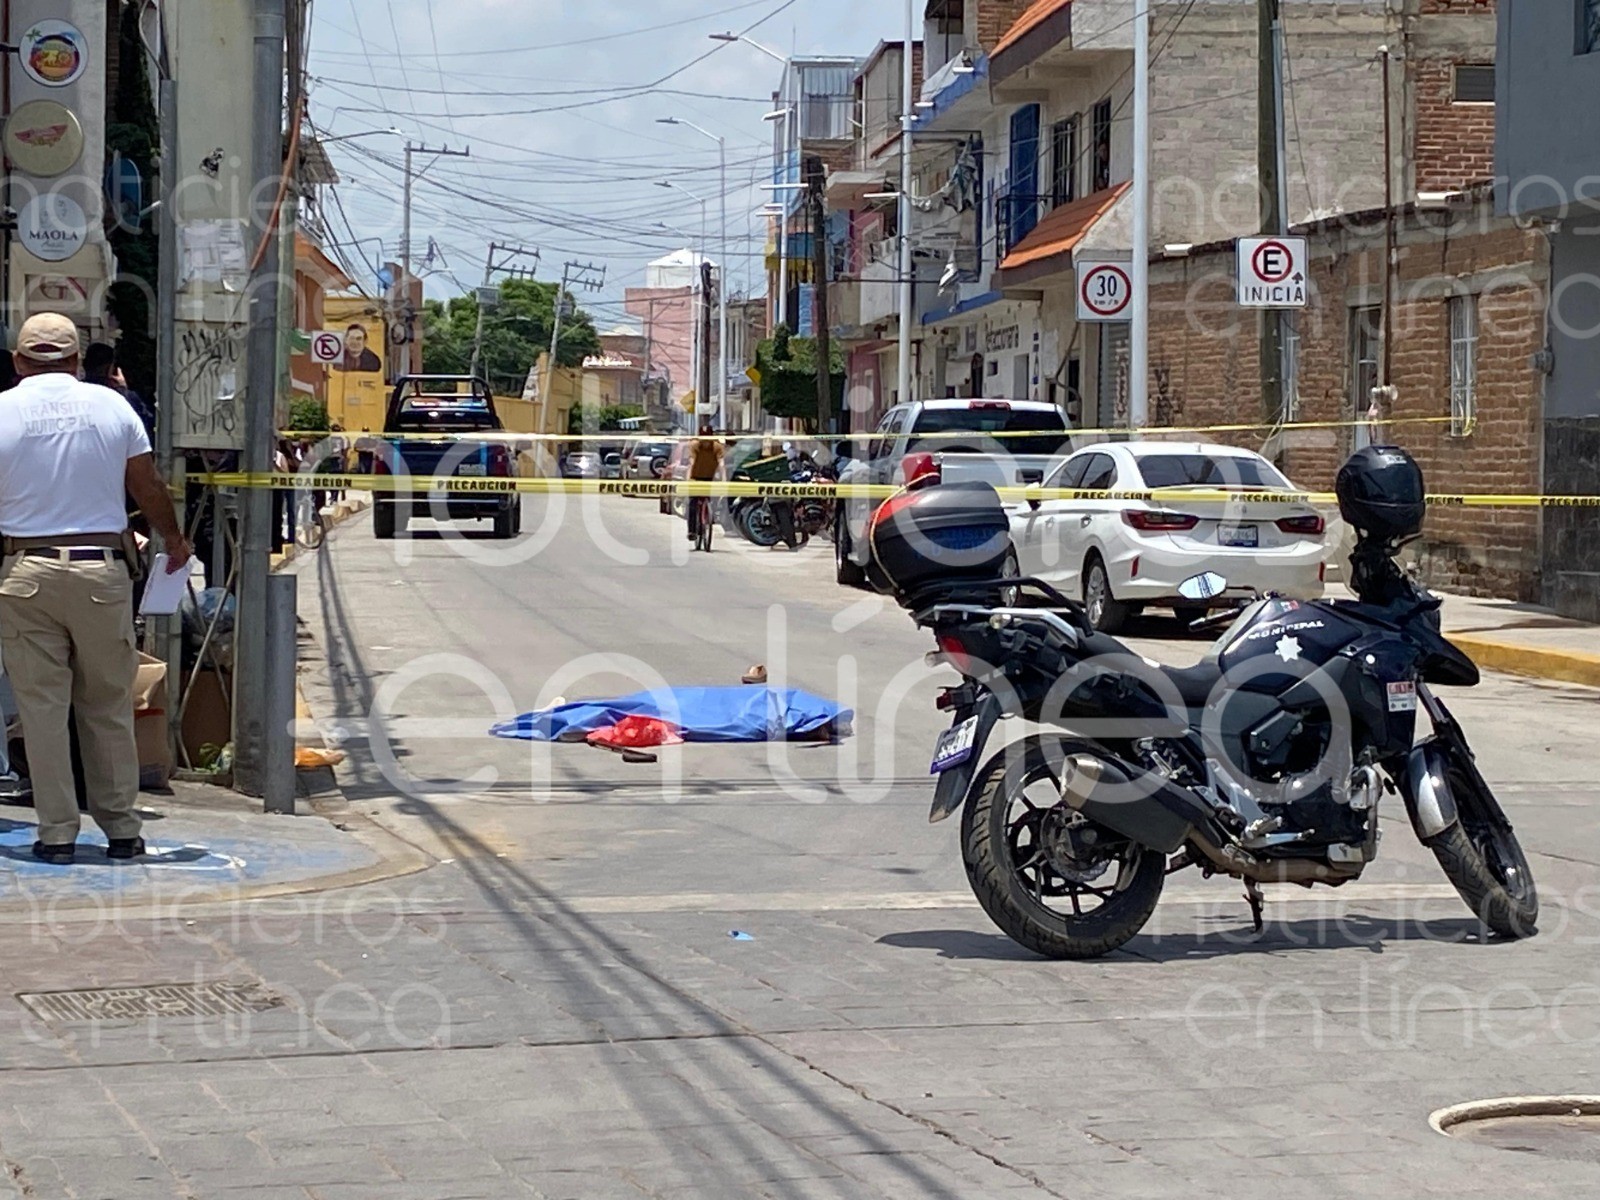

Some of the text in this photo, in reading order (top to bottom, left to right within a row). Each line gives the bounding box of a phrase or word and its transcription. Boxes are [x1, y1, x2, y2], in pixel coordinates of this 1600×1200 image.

[29, 230, 78, 240] MAOLA
[1263, 249, 1282, 275] E
[1096, 275, 1117, 297] 30
[1244, 286, 1304, 302] INICIA
